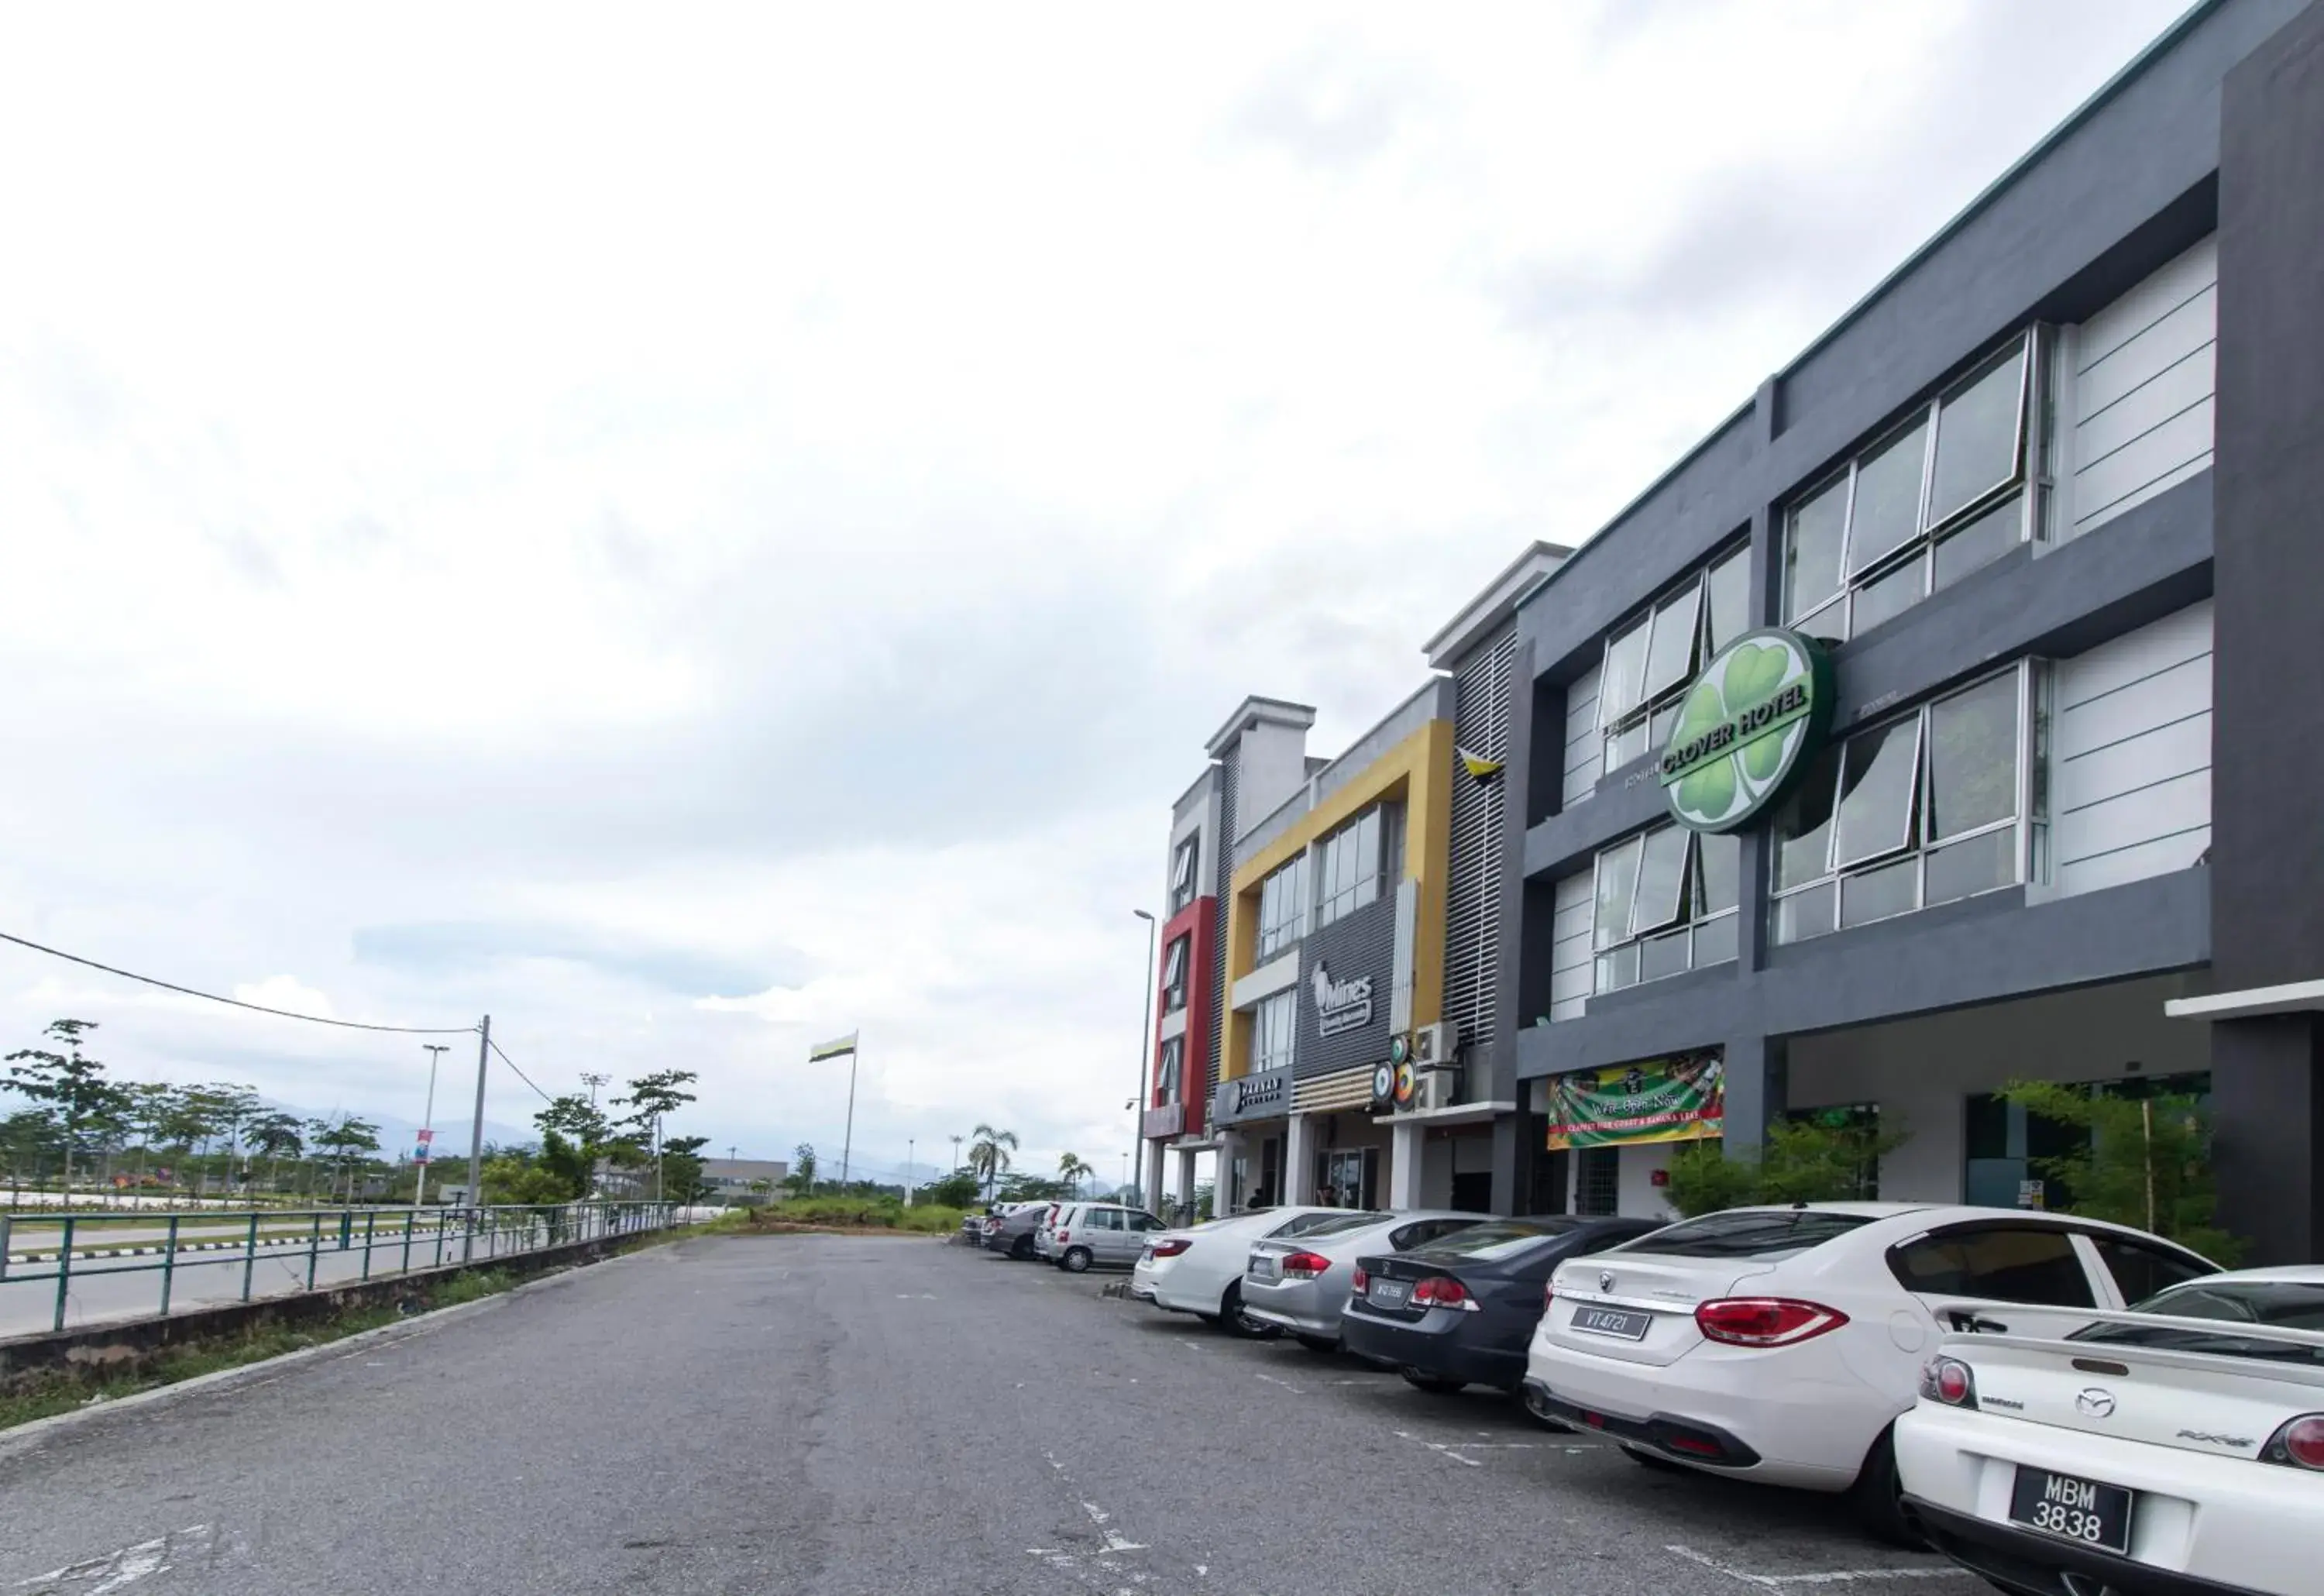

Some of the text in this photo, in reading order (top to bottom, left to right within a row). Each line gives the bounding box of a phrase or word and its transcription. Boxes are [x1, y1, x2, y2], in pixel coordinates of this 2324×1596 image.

[1663, 721, 1734, 774] CLOVER
[1738, 685, 1807, 735] HOTEL
[2045, 1475, 2095, 1511] MBM
[2033, 1501, 2102, 1542] 3838
